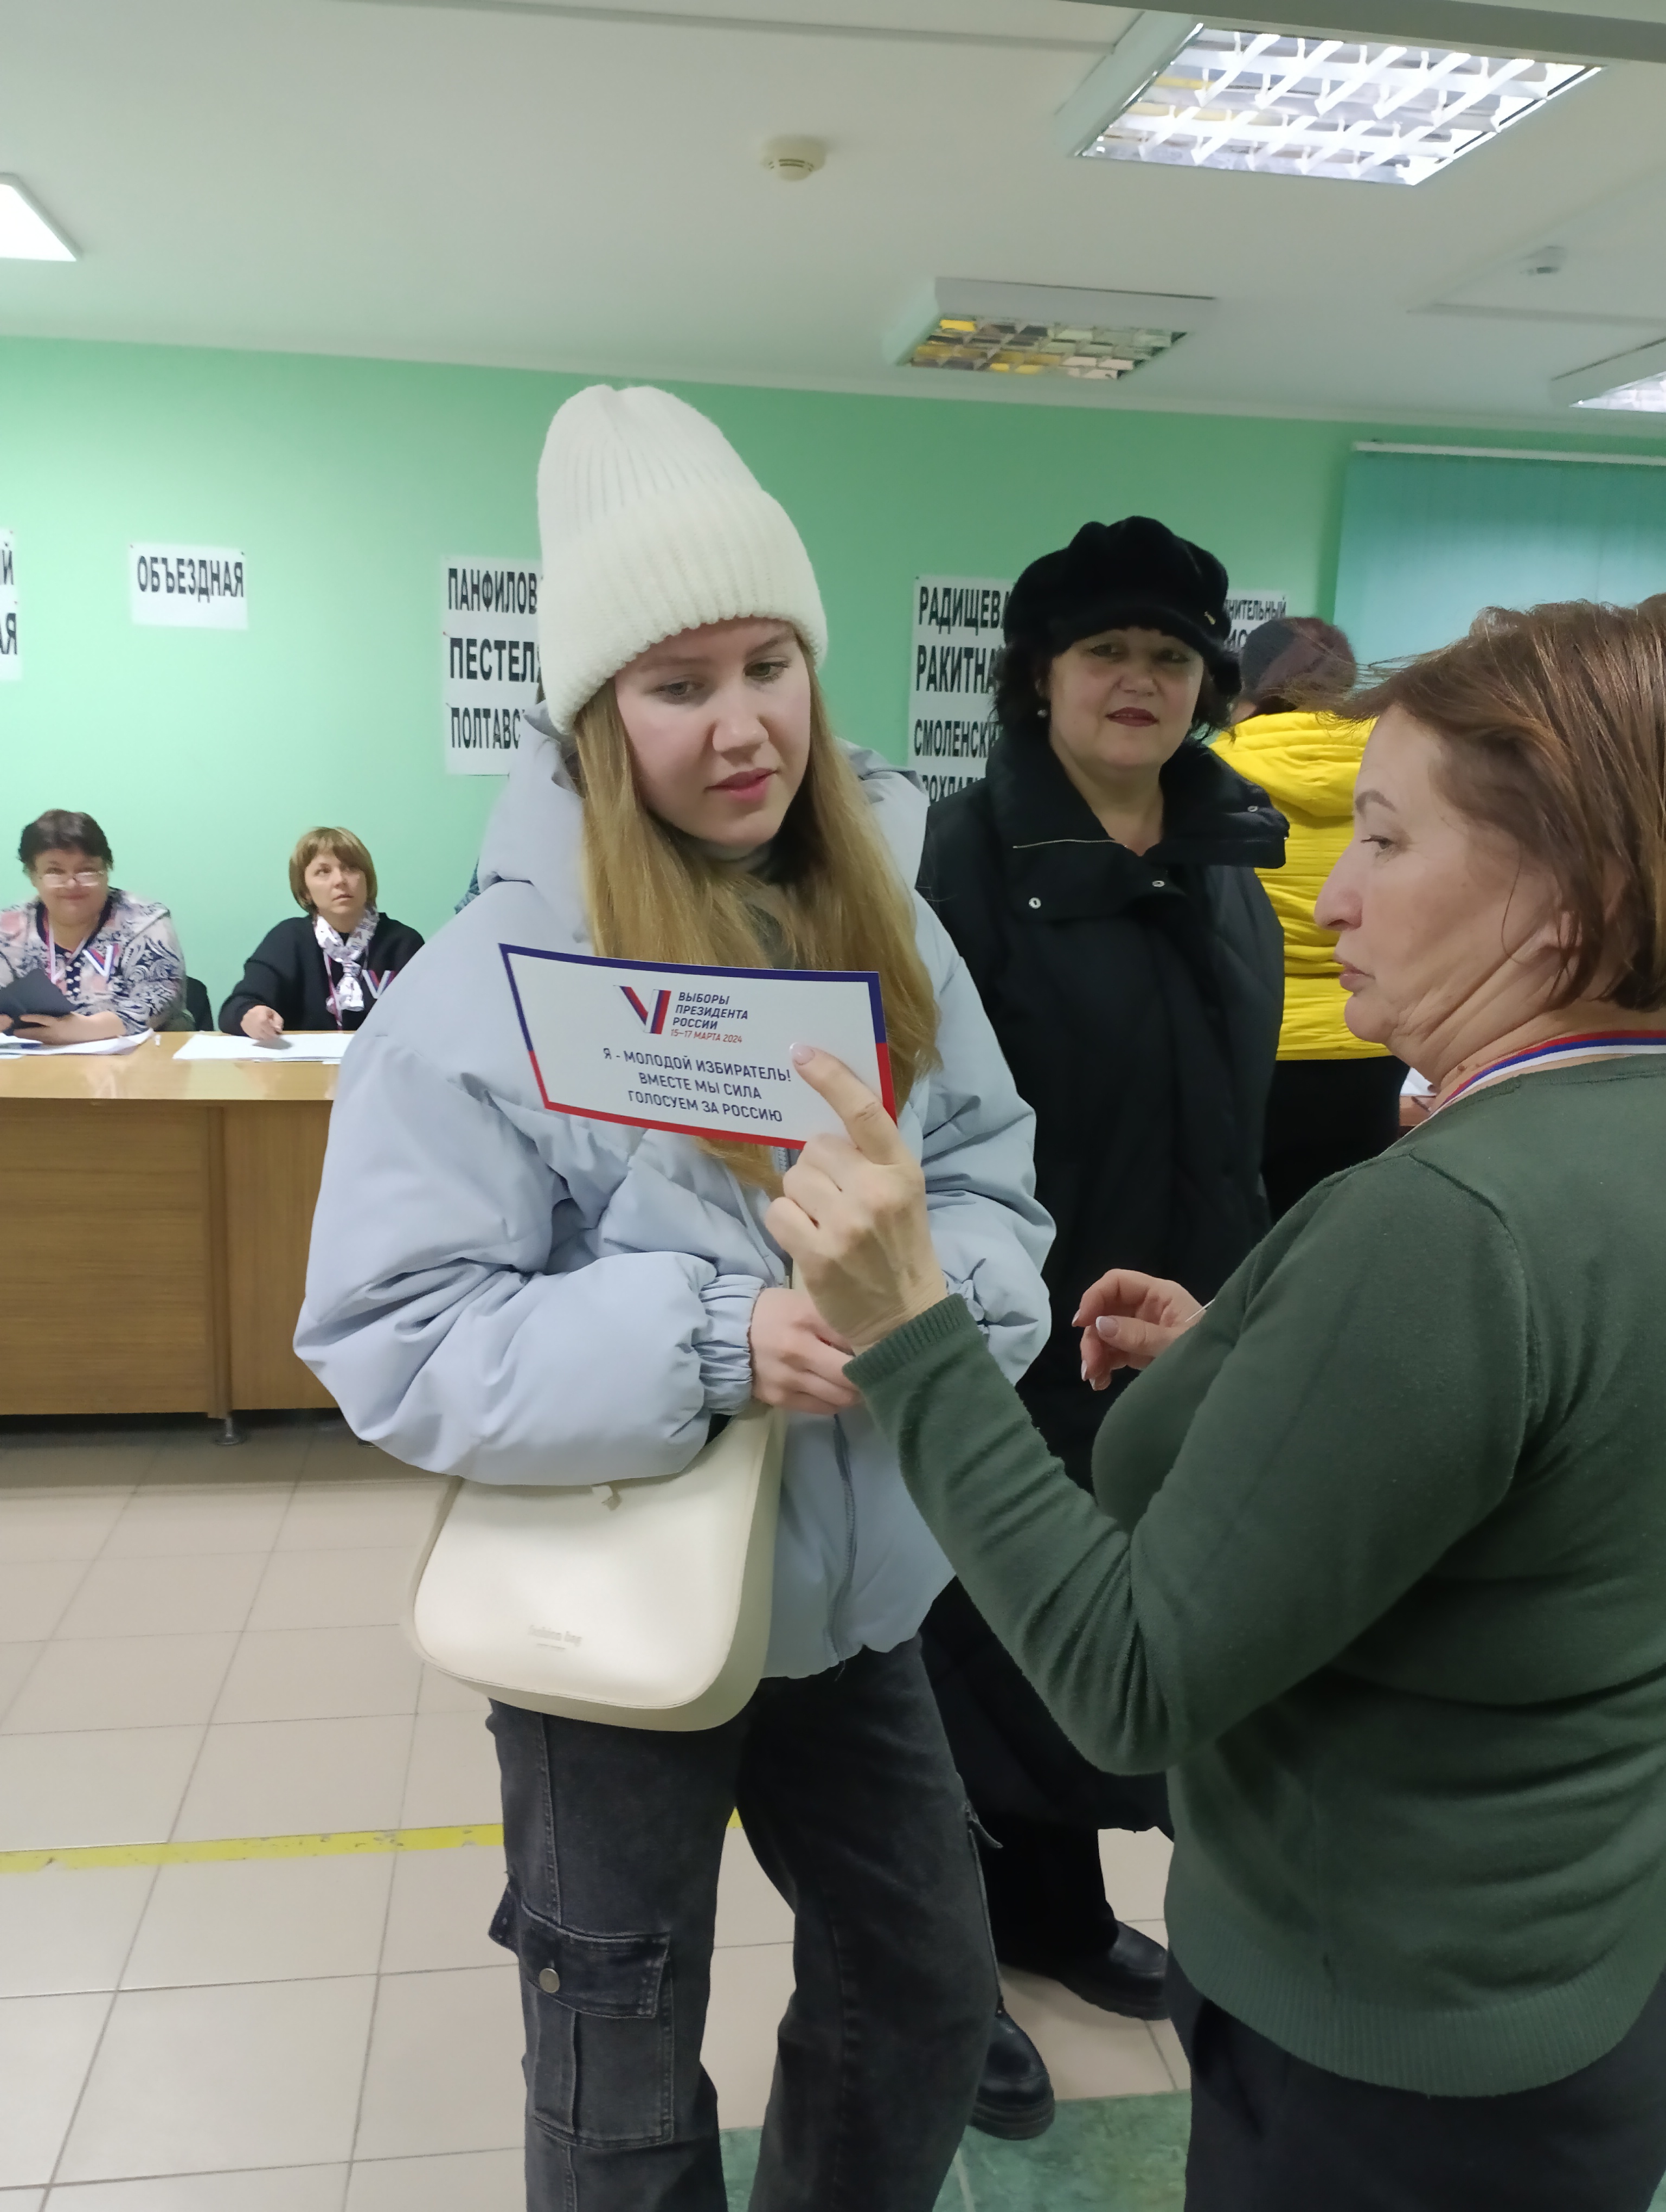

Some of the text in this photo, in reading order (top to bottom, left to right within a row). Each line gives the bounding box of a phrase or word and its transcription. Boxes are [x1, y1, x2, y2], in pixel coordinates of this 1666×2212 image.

[137, 555, 244, 603] ОБЪЕЗДНАЯ
[448, 568, 537, 614] ПАНФИЛОВ
[918, 586, 1010, 636] РАДИЩЕВ
[450, 638, 541, 683] ПЕСТЕЛ
[451, 707, 526, 749] ПОЛТАВС
[675, 1005, 748, 1020] ПРЕЗИДЕНТА
[678, 992, 730, 1005] ВЫБОРЫ
[672, 1017, 718, 1030] РОССИИ
[694, 1031, 721, 1041] МАРТА
[722, 1034, 742, 1043] 2024
[603, 1048, 612, 1059] Я
[624, 1050, 693, 1071] МОЛОДОЙ
[696, 1059, 791, 1082] ИЗБИРАТЕЛЬ!
[638, 1072, 762, 1099] ВМЕСТЕ МЫ СИЛА
[628, 1090, 783, 1122] ГОЛОСУЕМ ЗА РОССИЮ
